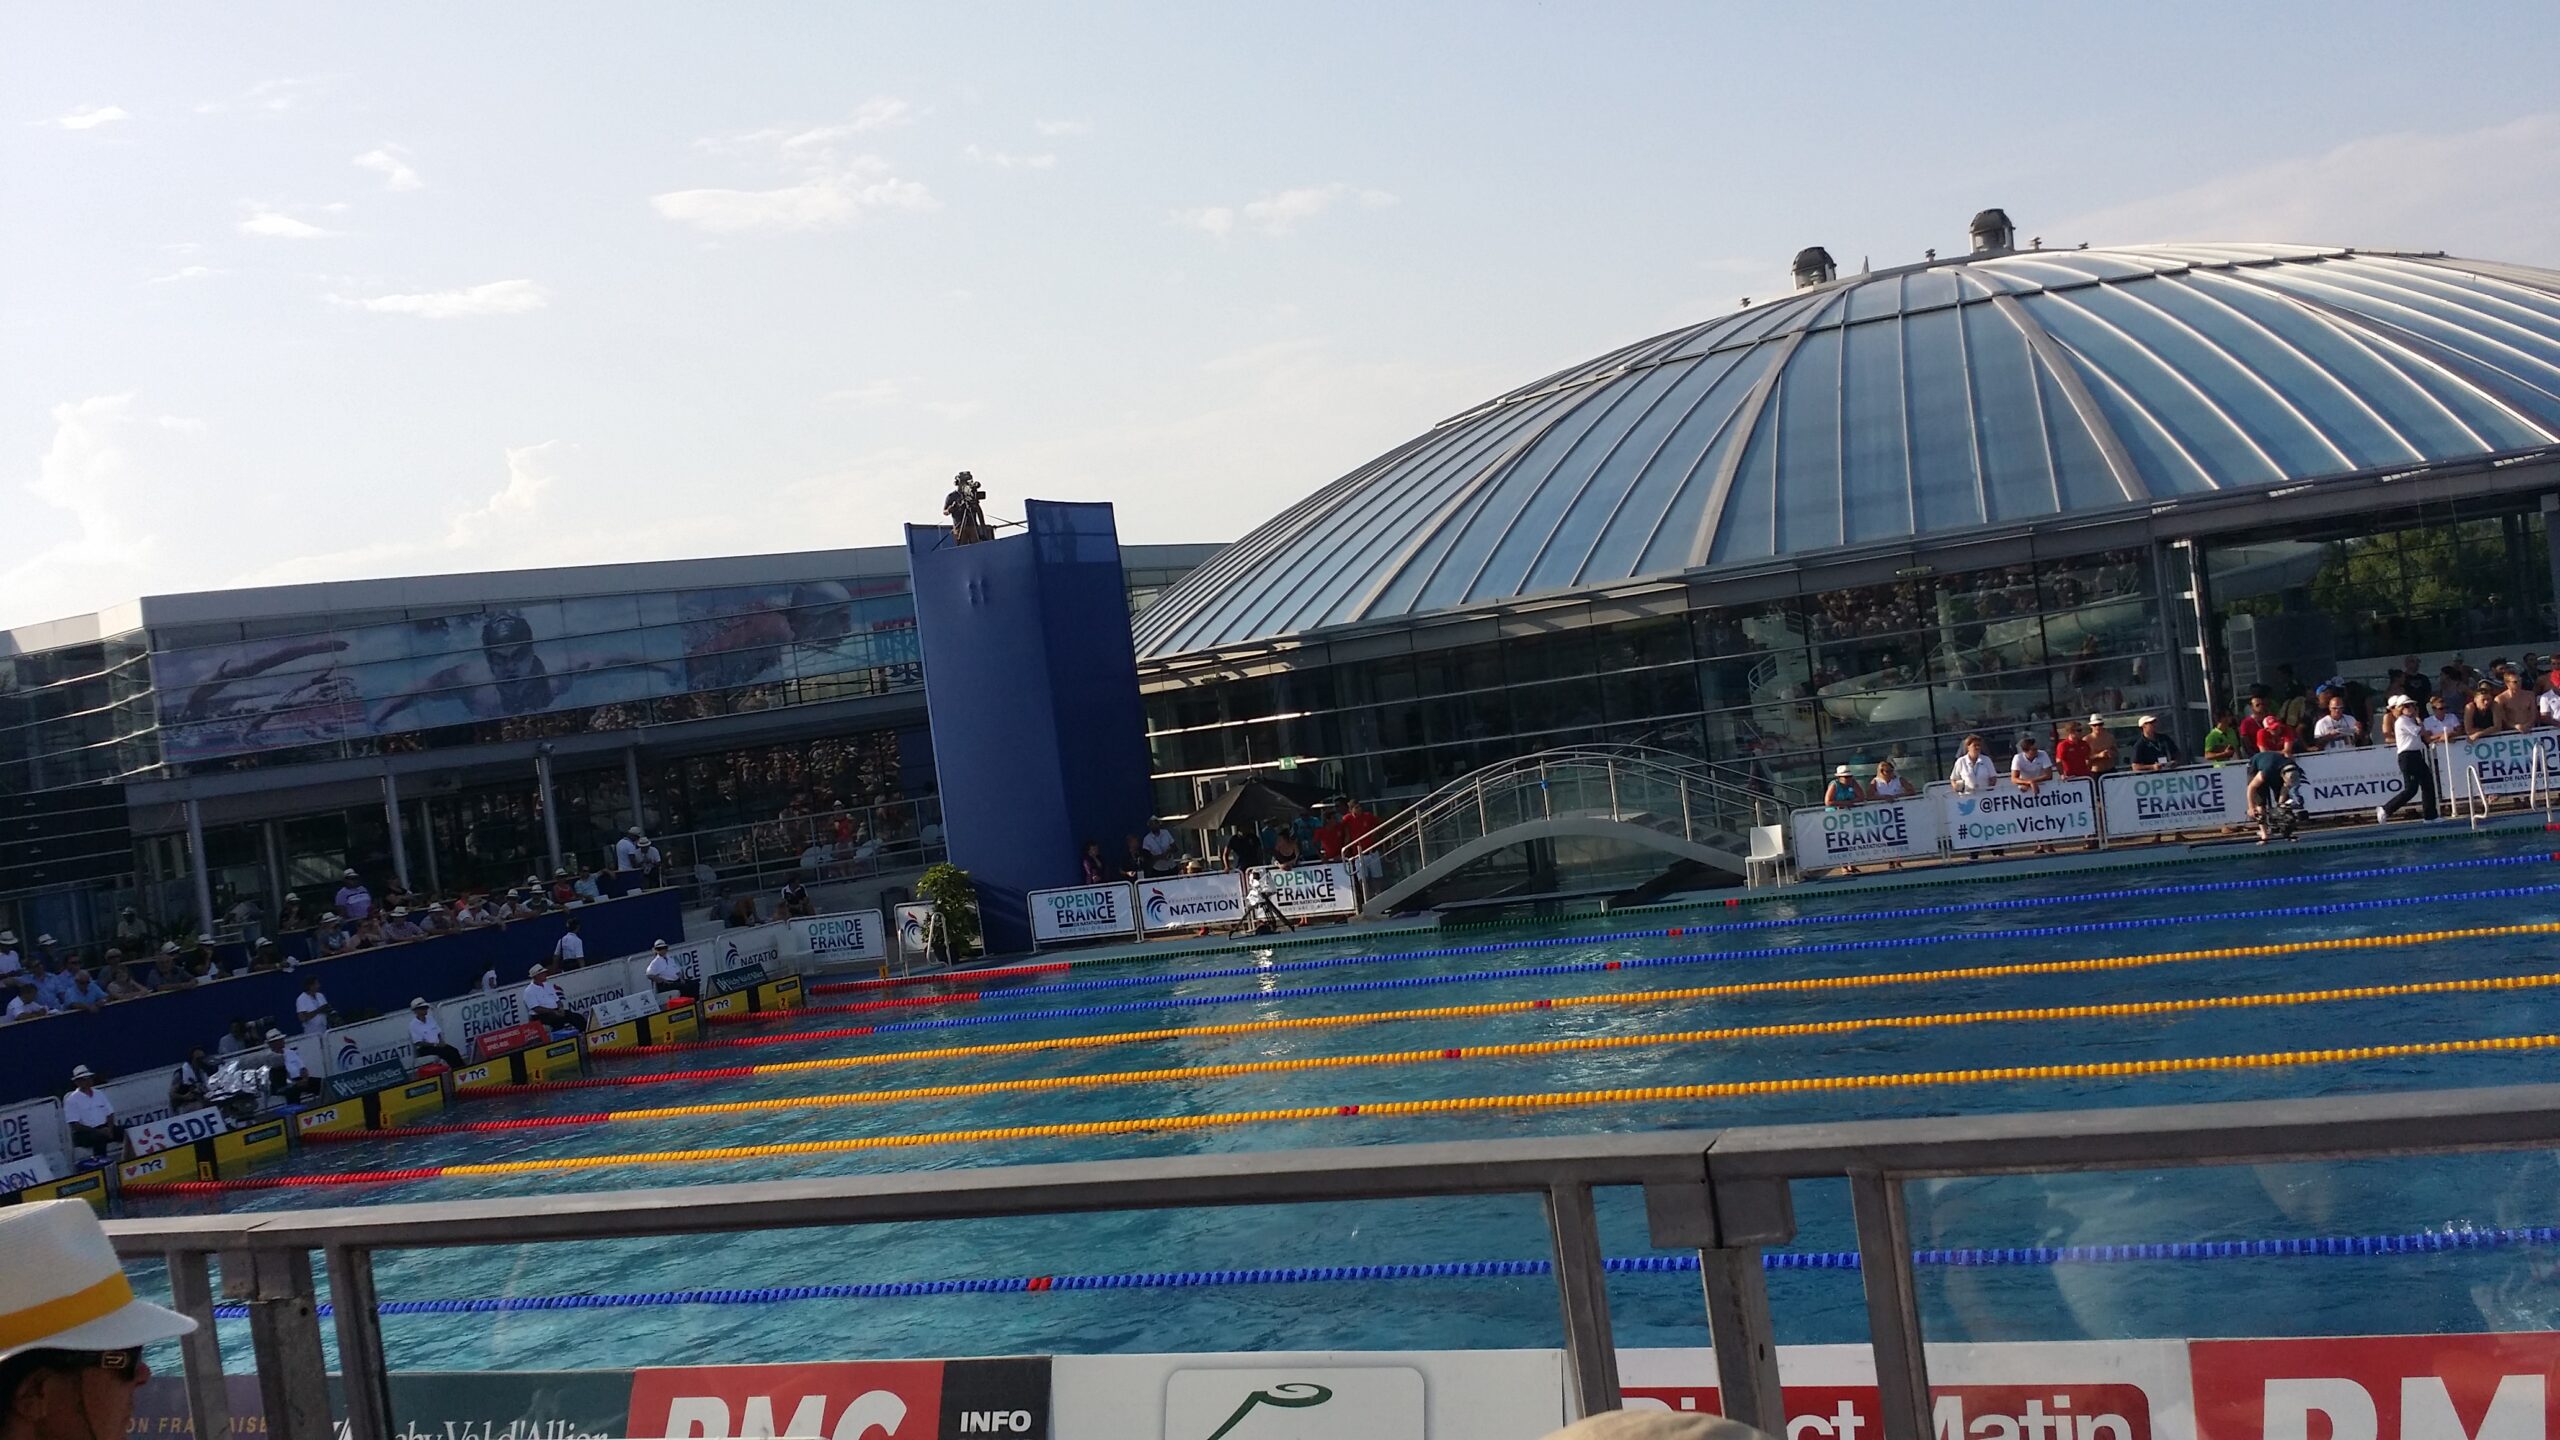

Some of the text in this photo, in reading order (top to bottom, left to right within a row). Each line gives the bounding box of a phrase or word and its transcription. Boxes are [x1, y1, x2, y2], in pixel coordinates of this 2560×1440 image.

[2478, 753, 2560, 778] FRANC
[2314, 779, 2403, 799] NATATIO
[1980, 790, 2083, 813] @FFNatation
[2136, 790, 2225, 814] FRANCE
[2171, 809, 2202, 818] NATATION
[1958, 811, 2088, 841] #OpenVichy15
[1825, 824, 1908, 848] FRANCE
[1858, 843, 1887, 851] NATATION
[1276, 883, 1336, 902] FRANCE
[1057, 905, 1116, 923] FRANCE
[1169, 899, 1239, 916] NATATION
[810, 932, 864, 949] FRANCE
[568, 988, 624, 1013] NATATION
[716, 999, 730, 1010] TYR
[463, 1010, 520, 1038] FRANCE
[601, 1031, 616, 1043] TYR
[469, 1068, 486, 1081] TYR
[316, 1110, 335, 1123] TYR
[140, 1159, 164, 1174] TYR
[960, 1410, 1032, 1433] INFO
